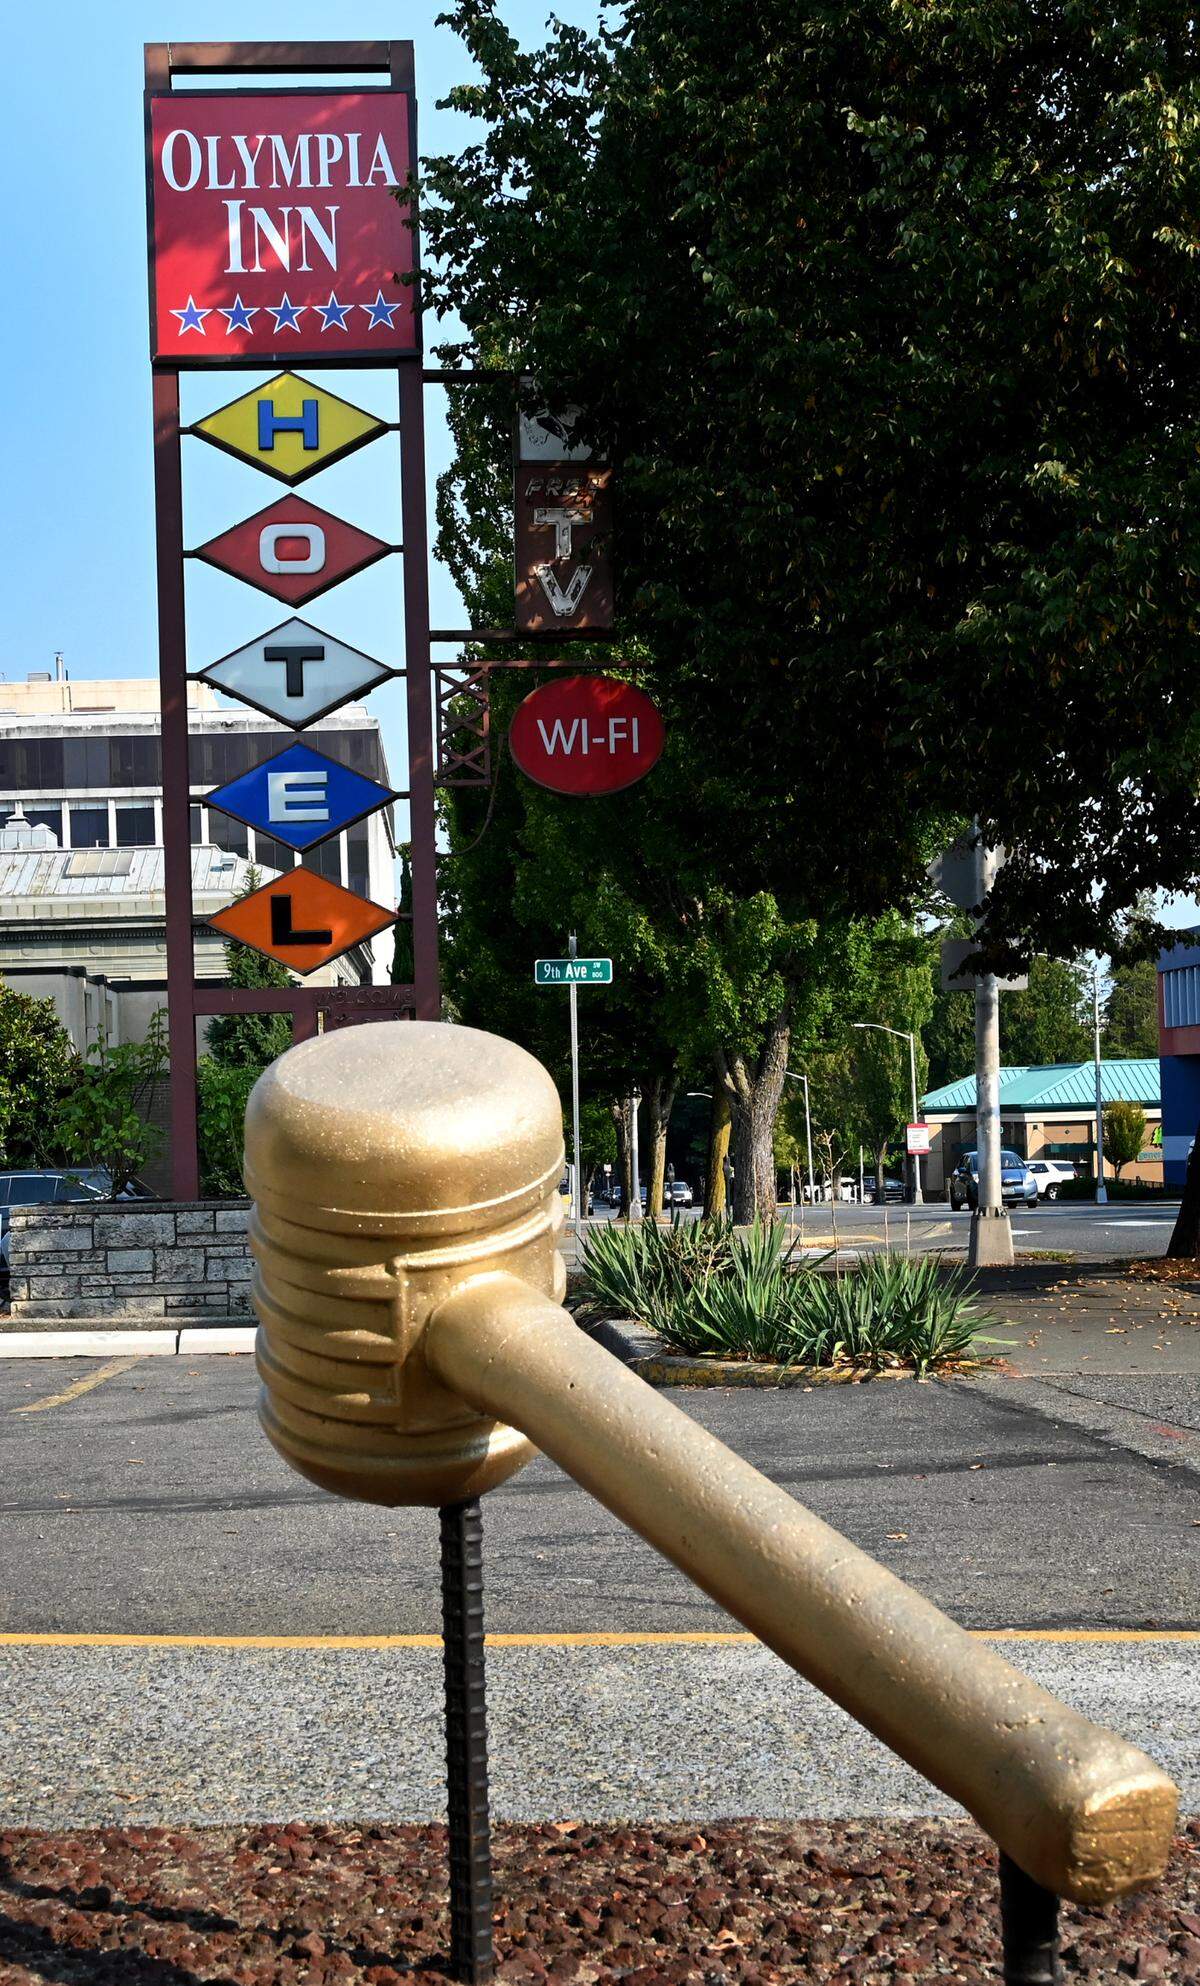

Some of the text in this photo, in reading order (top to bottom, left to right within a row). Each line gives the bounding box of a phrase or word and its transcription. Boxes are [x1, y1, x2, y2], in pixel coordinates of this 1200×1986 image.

[161, 129, 400, 192] OLYMPIA
[221, 199, 340, 274] INN
[536, 717, 639, 755] WI-FI
[544, 962, 588, 979] 9th Ave
